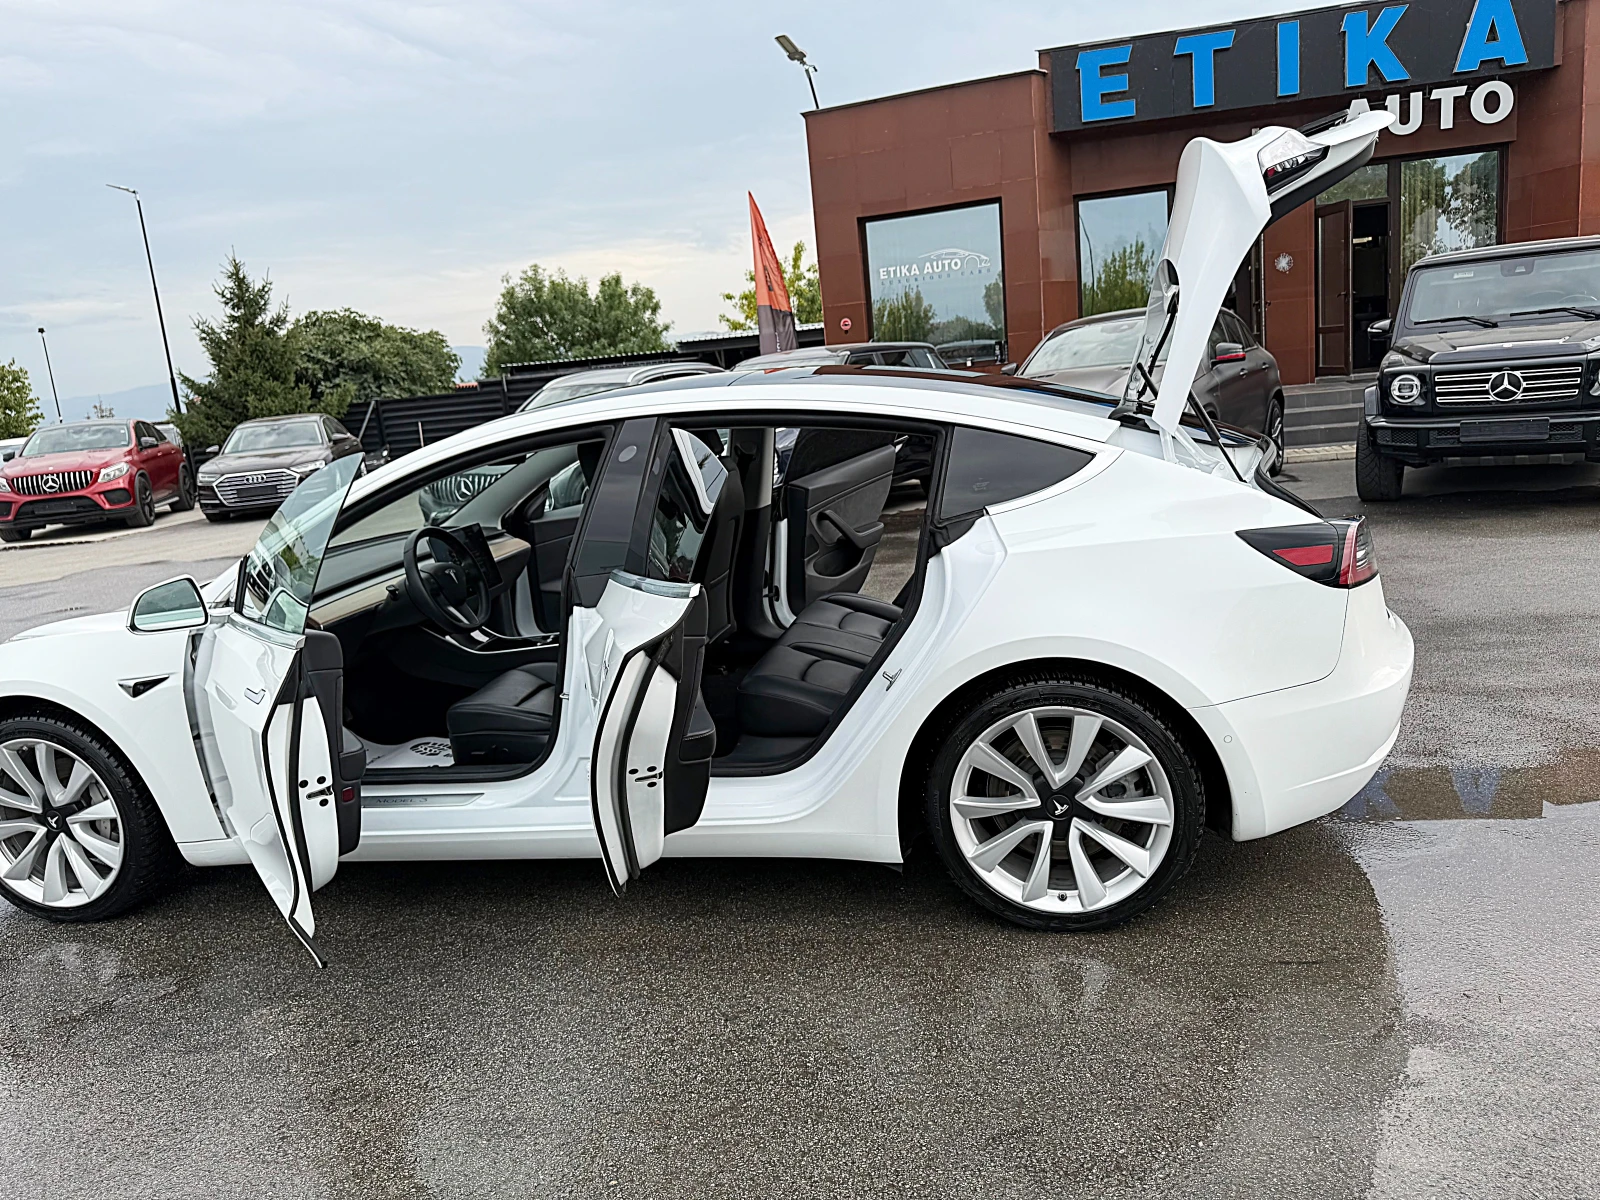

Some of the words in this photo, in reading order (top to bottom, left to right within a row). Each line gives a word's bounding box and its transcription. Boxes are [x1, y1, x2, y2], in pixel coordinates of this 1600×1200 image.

[1075, 0, 1529, 123] ETIKA
[879, 264, 920, 280] ETIKA
[923, 258, 961, 274] AUTO
